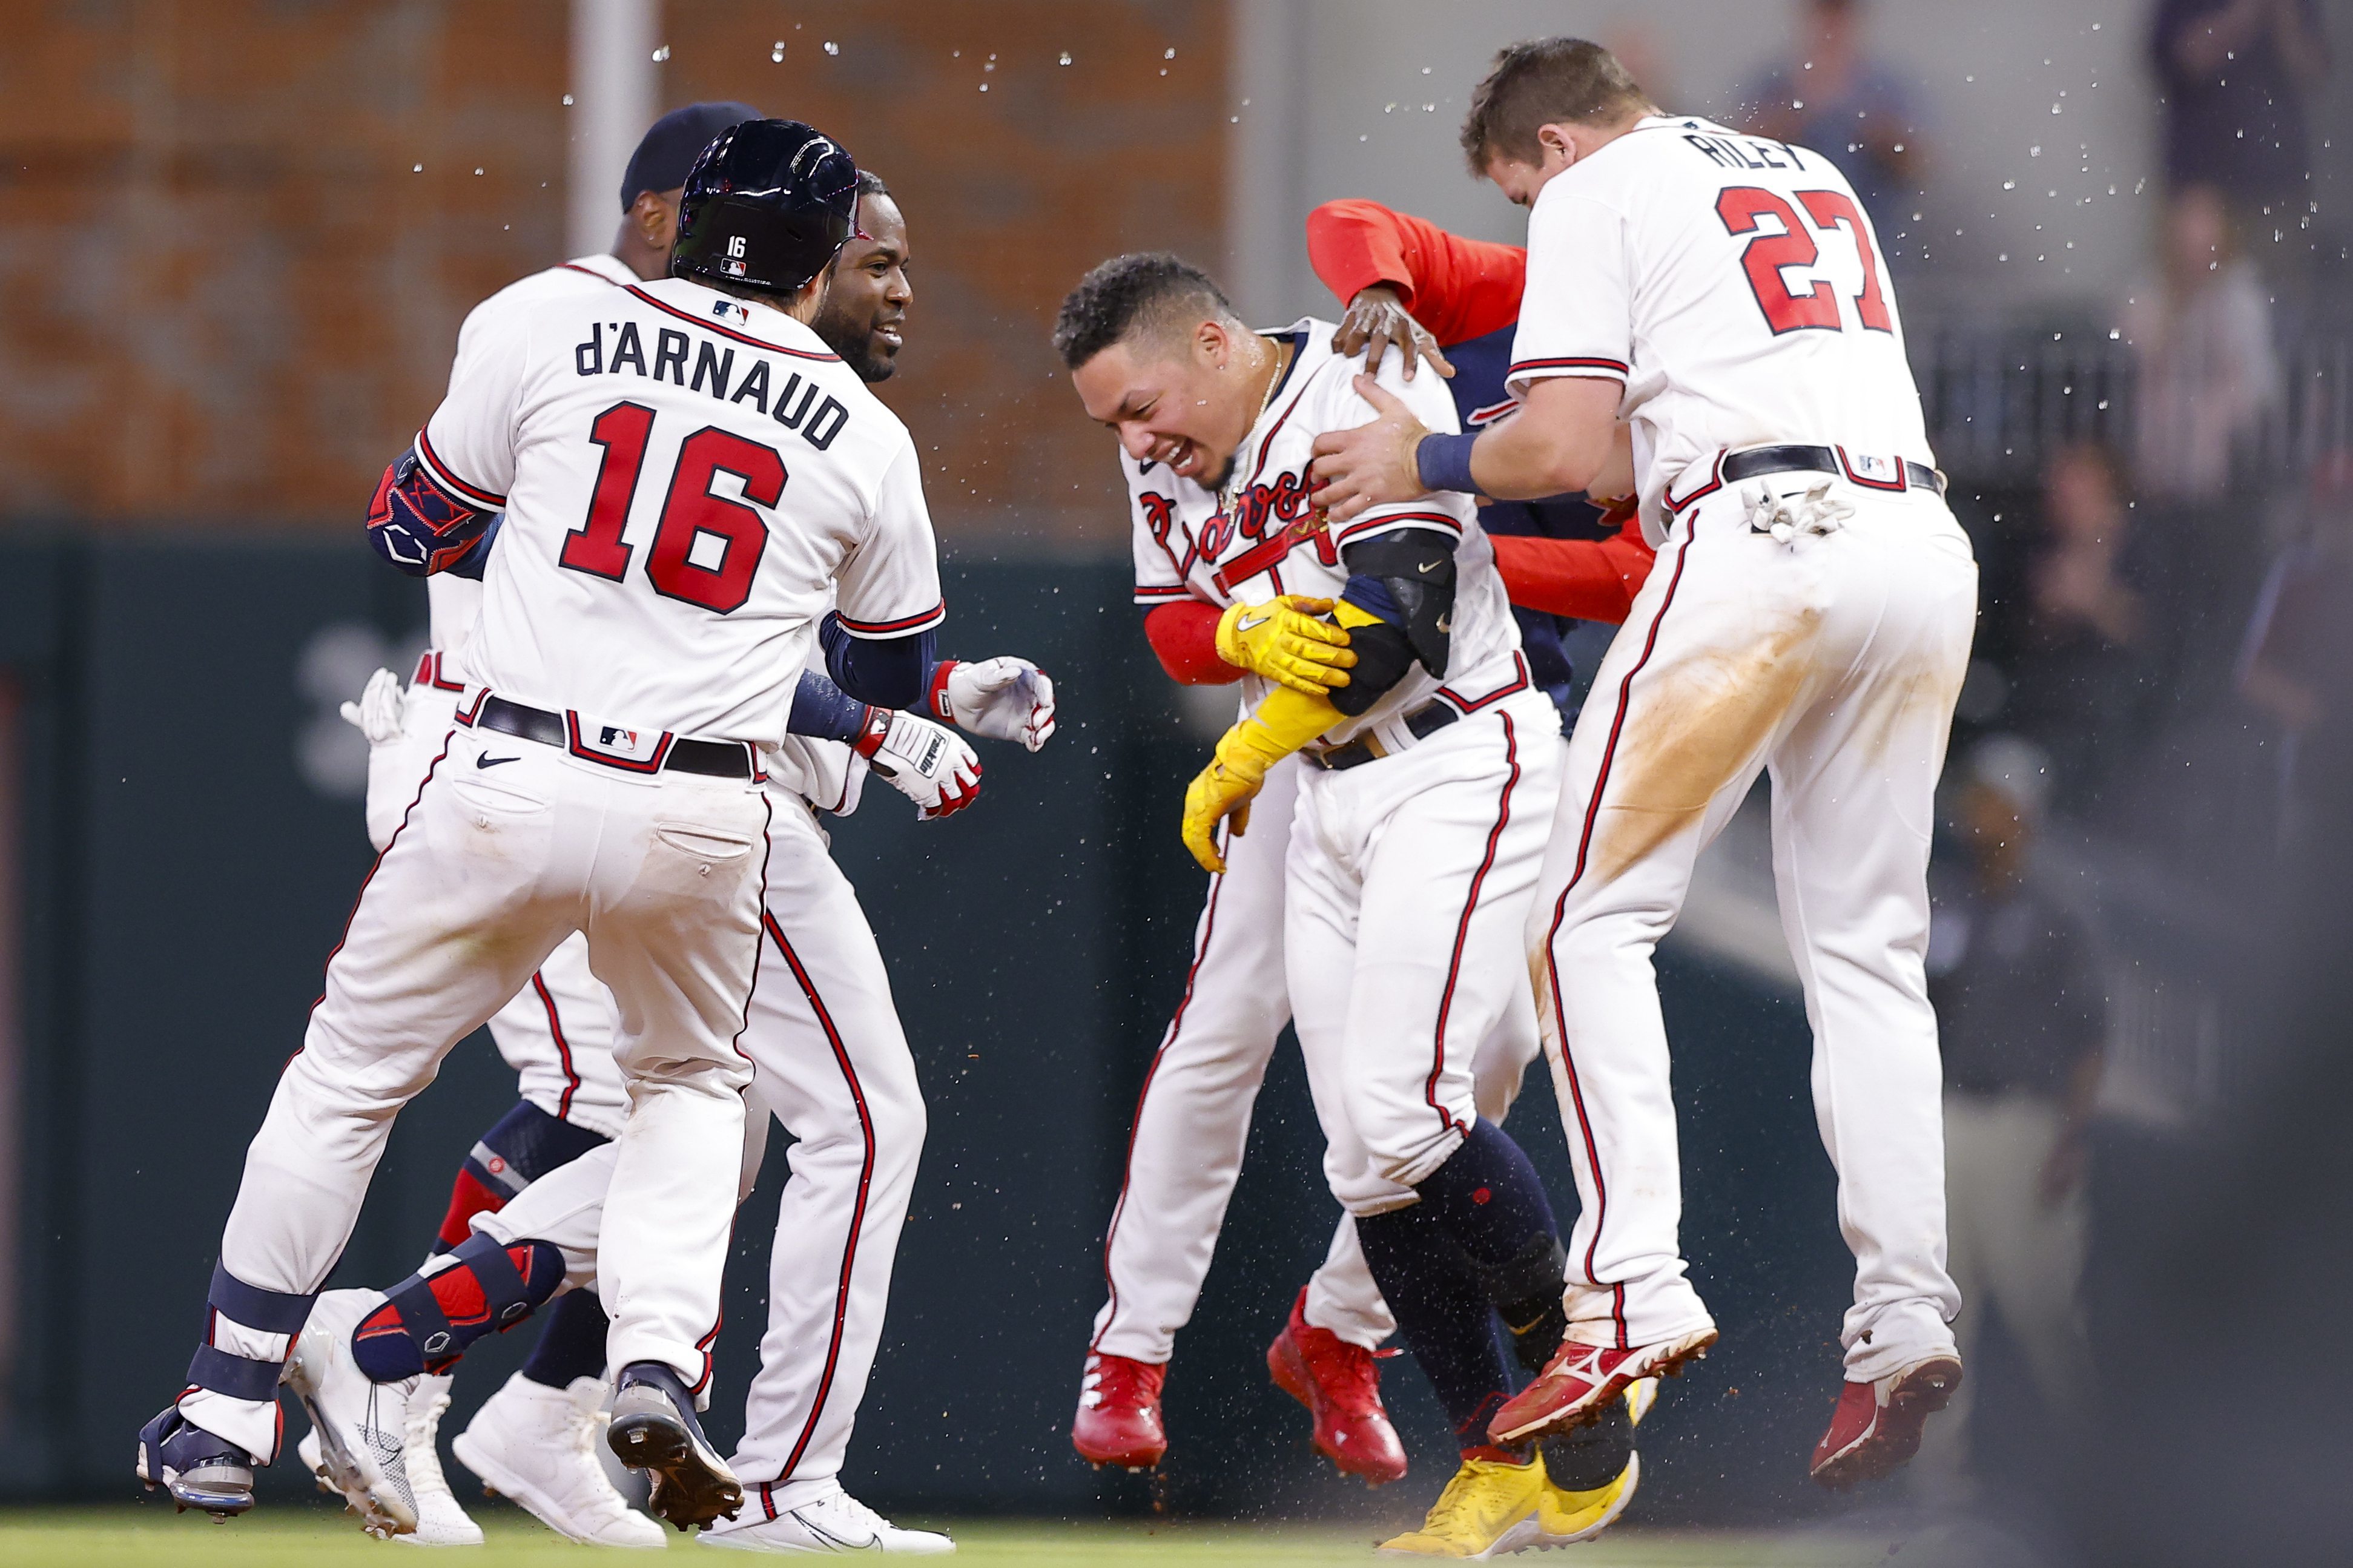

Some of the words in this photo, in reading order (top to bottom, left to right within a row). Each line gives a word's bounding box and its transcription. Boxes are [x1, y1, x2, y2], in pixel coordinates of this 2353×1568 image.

[1681, 134, 1806, 172] RILEY
[727, 236, 746, 258] 16
[1714, 185, 1894, 337] 27
[575, 322, 849, 451] d'ARNAUD
[558, 400, 788, 615] 16
[919, 729, 946, 774] Franklin
